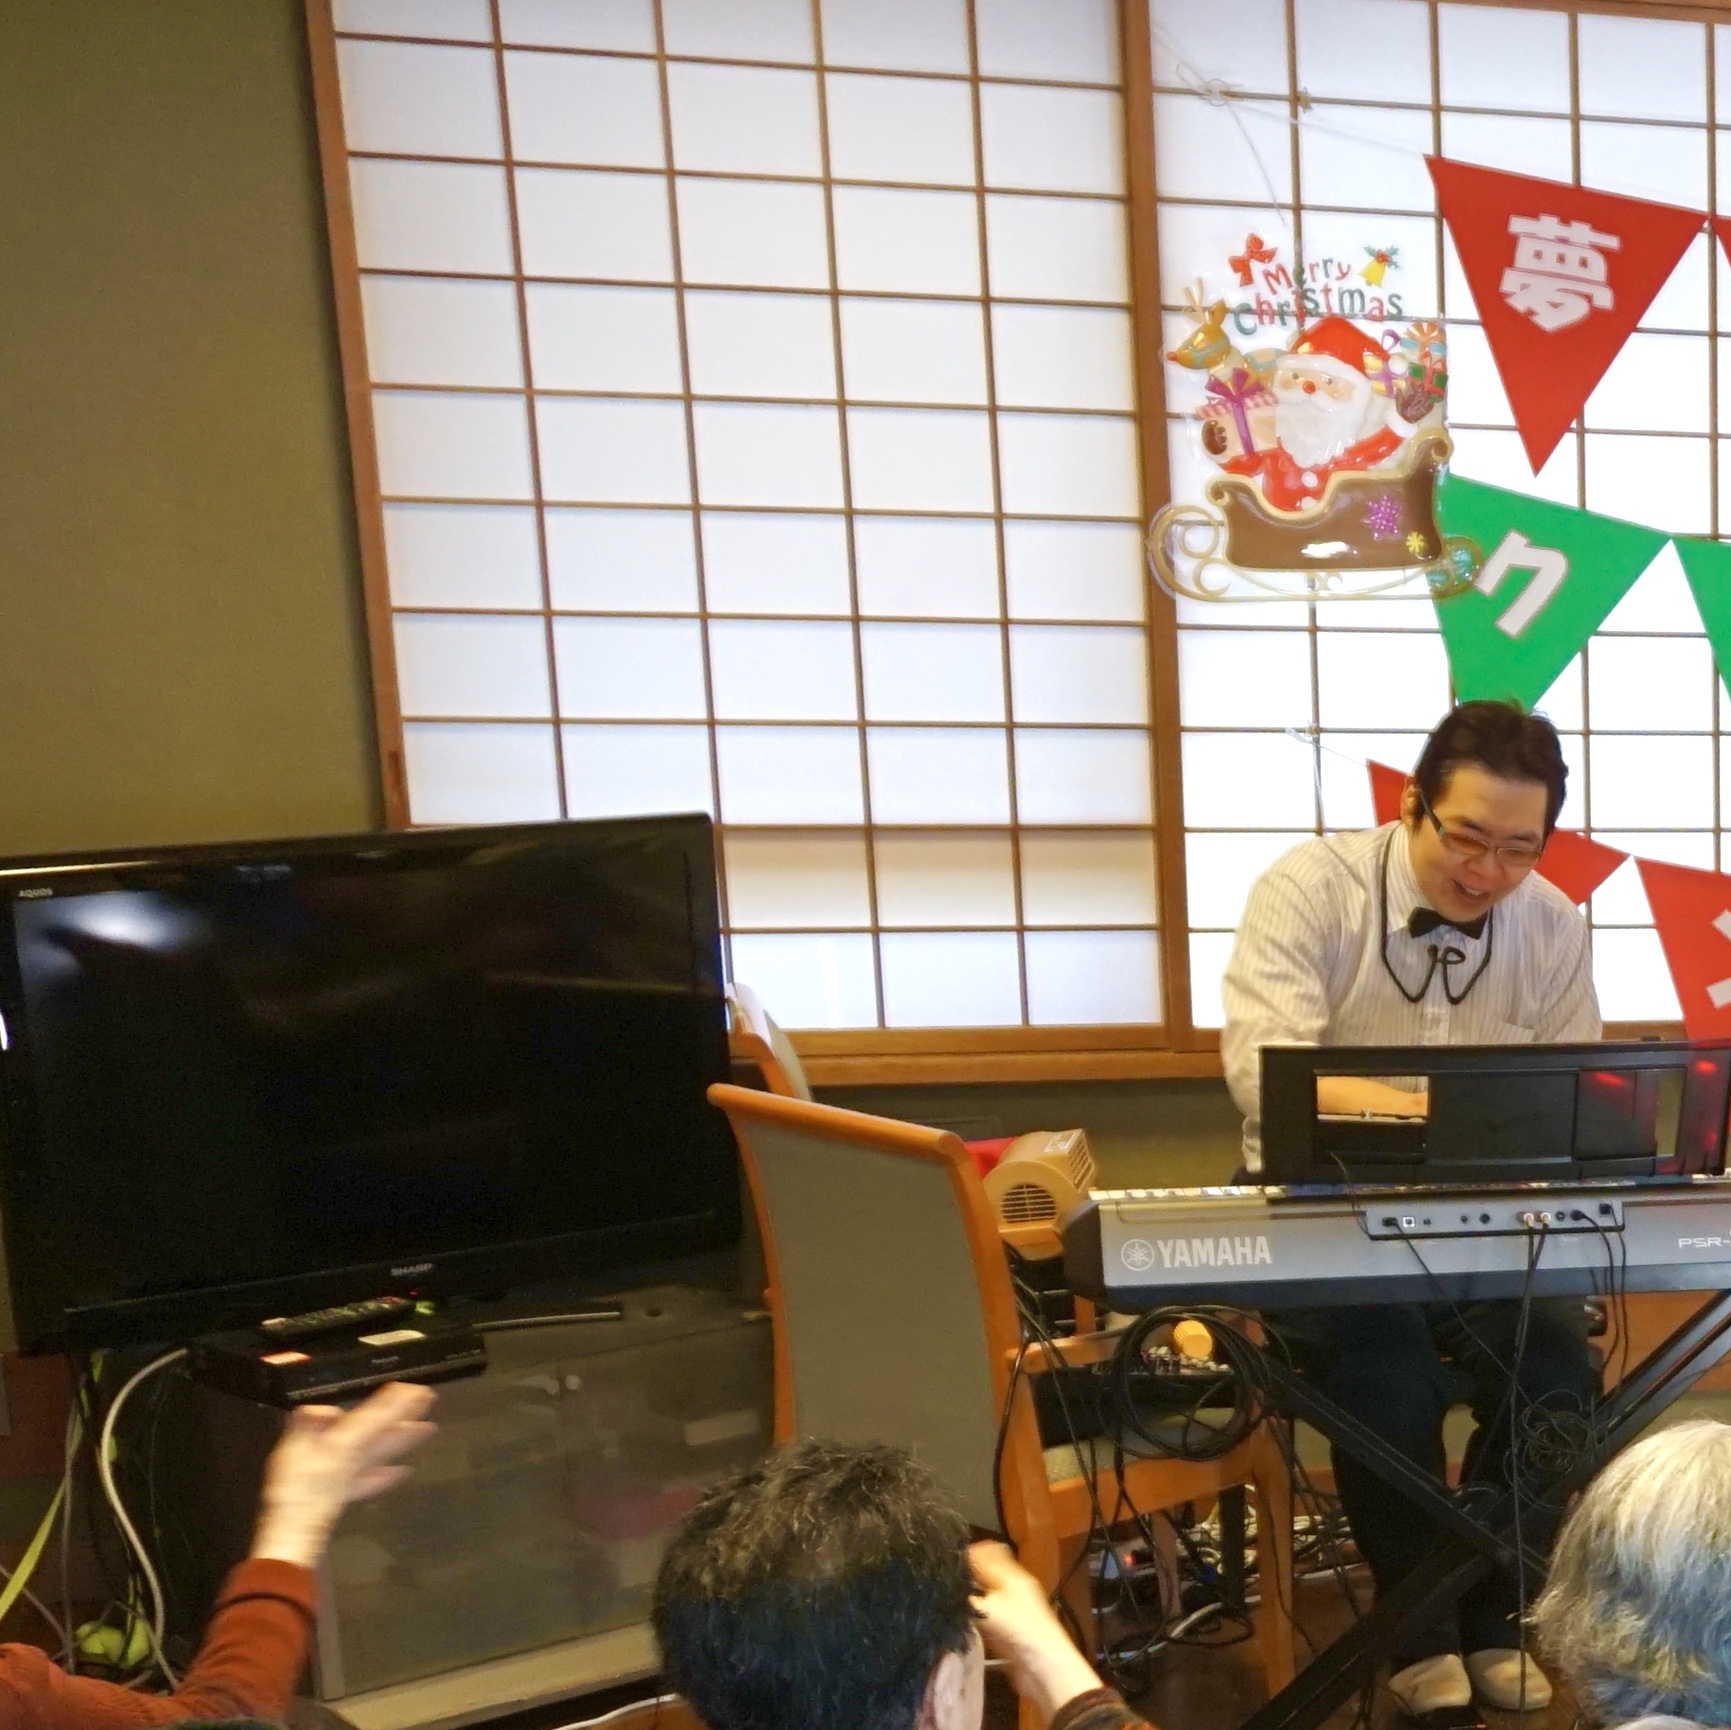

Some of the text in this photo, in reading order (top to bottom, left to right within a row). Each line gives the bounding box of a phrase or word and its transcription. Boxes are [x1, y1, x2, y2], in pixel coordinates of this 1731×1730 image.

[1261, 257, 1352, 296] Merry
[1232, 282, 1404, 336] Christmas
[1156, 1235, 1273, 1268] YAMAHA
